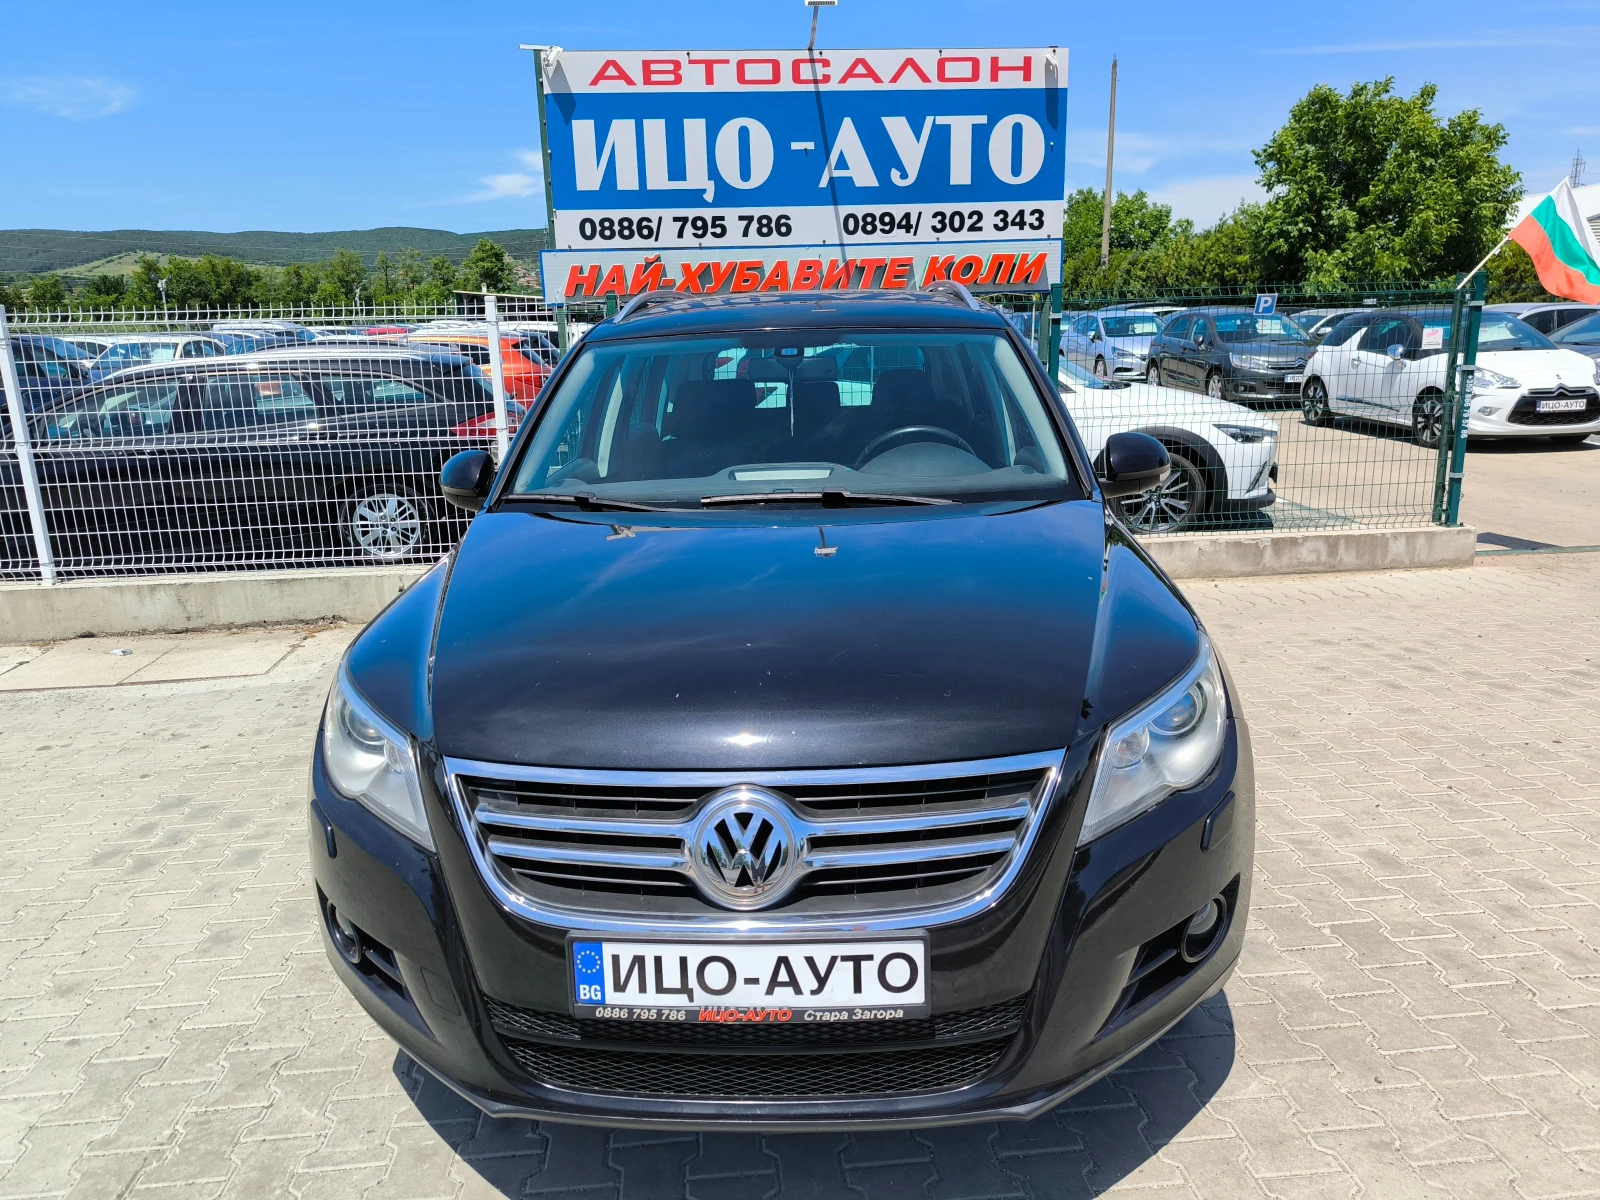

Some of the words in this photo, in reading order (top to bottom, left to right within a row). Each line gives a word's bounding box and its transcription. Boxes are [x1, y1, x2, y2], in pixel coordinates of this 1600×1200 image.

[588, 56, 1033, 87] АВТОСАЛОН
[578, 216, 663, 242] 0886/
[672, 215, 728, 239] 795
[737, 214, 793, 238] 786
[842, 211, 922, 236] 0894/
[930, 210, 984, 233] 302
[992, 208, 1045, 231] 343
[563, 253, 914, 297] НАЙ-ХУБАВИТЕ
[921, 252, 1048, 286] КОЛИ
[1258, 296, 1273, 313] P
[1541, 400, 1585, 410] ИЦО-АУТО
[610, 951, 919, 1003] ИЦО-АУТО
[579, 984, 602, 1001] BG
[595, 1007, 628, 1019] 0886
[632, 1008, 657, 1020] 795
[661, 1009, 686, 1021] 786
[698, 1007, 793, 1023] ИЦО-АУТО
[803, 1009, 848, 1022] Стара
[852, 1008, 904, 1021] Загора
